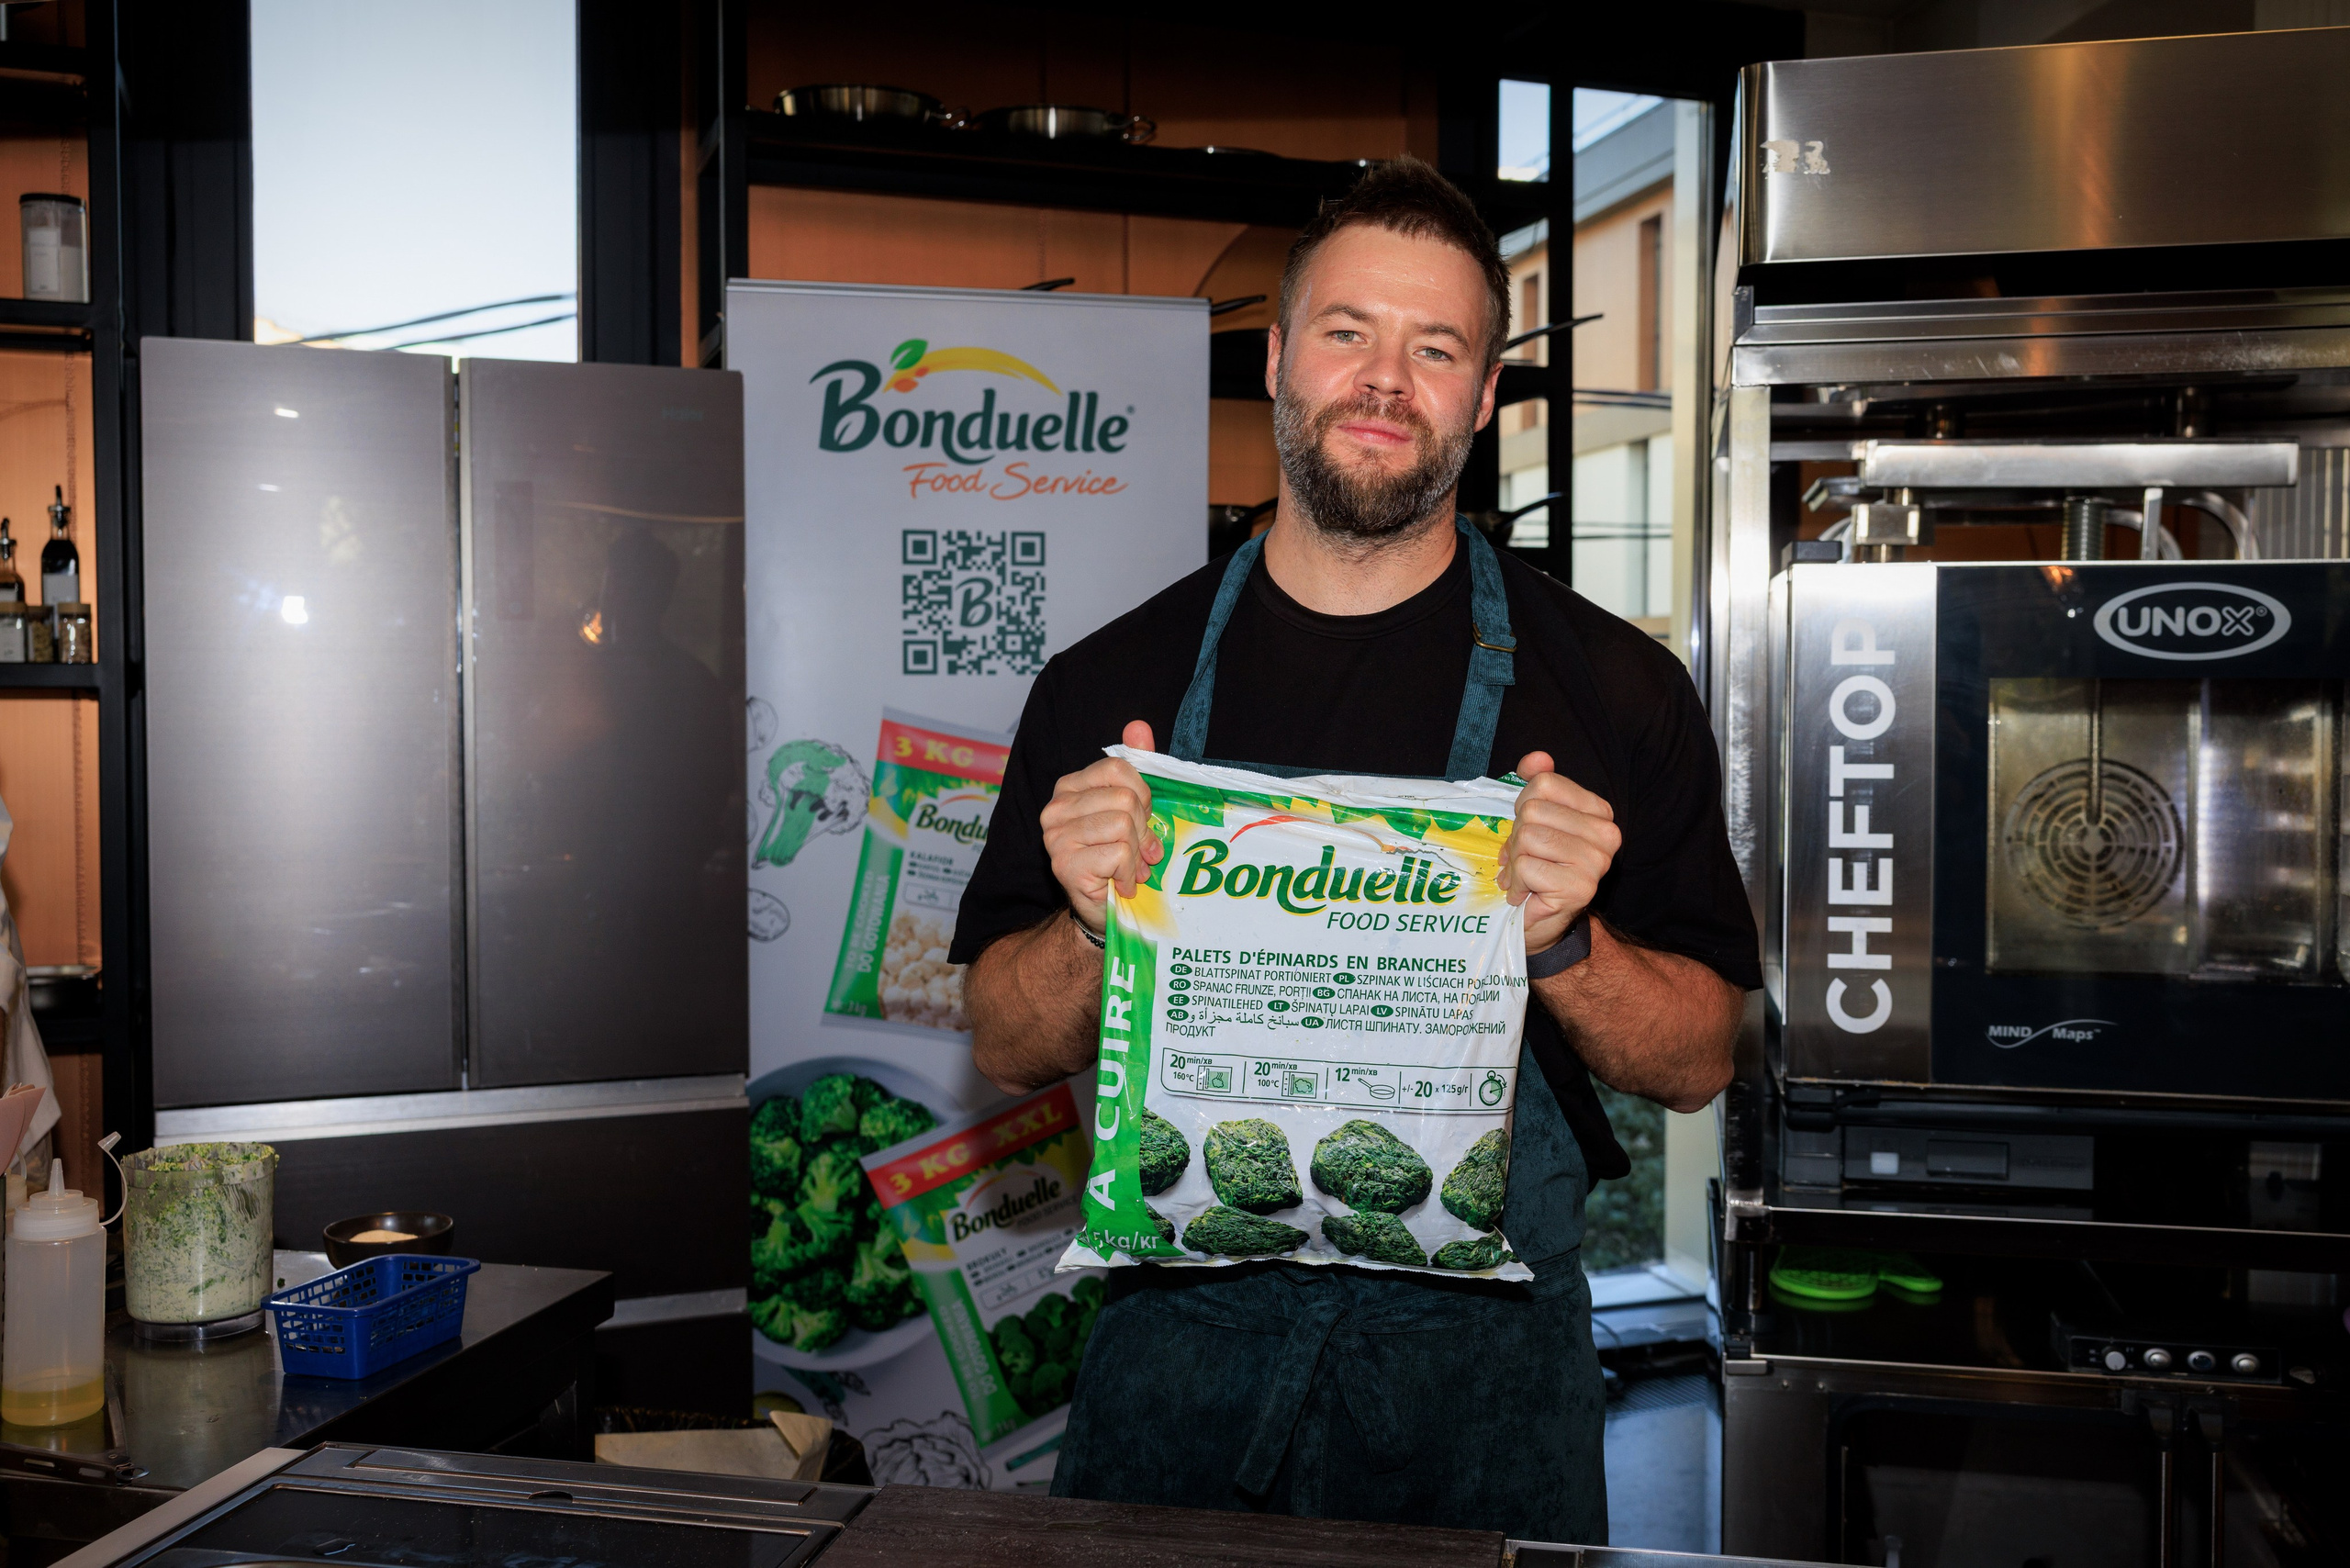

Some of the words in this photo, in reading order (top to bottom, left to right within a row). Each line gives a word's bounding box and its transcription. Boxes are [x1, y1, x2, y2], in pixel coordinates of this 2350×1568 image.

[902, 462, 988, 498] Food
[990, 462, 1128, 500] Service
[955, 577, 993, 627] B
[894, 736, 913, 757] 3
[923, 739, 975, 767] KG
[916, 803, 990, 845] Bondu
[1826, 617, 1897, 1035] CHEFTOP
[1177, 838, 1462, 916] Bonduelle
[1326, 912, 1389, 932] FOOD
[1395, 913, 1490, 934] SERVICE
[1172, 947, 1231, 964] PALETS
[1239, 949, 1338, 969] D'ÉPINARDS
[1347, 956, 1368, 969] EN
[1377, 957, 1467, 973] BRANCHES
[1171, 980, 1188, 990] RO
[1193, 980, 1233, 994] SPANAC
[1235, 982, 1276, 997] FRUNZE,
[1172, 965, 1190, 975] DE
[1194, 967, 1261, 980] BLATTSPINAT
[1264, 970, 1332, 983] PORTIONIERT
[1336, 974, 1352, 983] PL
[1357, 974, 1401, 986] SZPINAK
[1404, 976, 1415, 987] W
[1418, 975, 1464, 989] LIŚCIACH
[1170, 995, 1187, 1005] EE
[1192, 995, 1263, 1010] SPINATILEHED
[1270, 1001, 1287, 1011] LT
[1292, 999, 1337, 1017] ŠPINATŲ
[1339, 1003, 1370, 1016] LAPAI
[1373, 1006, 1390, 1015] LV
[1395, 1005, 1439, 1019] SPINĀTU
[1443, 1009, 1474, 1021] LAPAS
[1315, 988, 1332, 998] BG
[1337, 988, 1381, 1001] СПАНАК
[1383, 990, 1399, 1002] НА
[1401, 991, 1440, 1004] ЛИСТА,
[1443, 992, 1458, 1004] НА
[1169, 1010, 1186, 1020] AB
[1304, 1018, 1321, 1027] UA
[1325, 1018, 1362, 1031] ЛИСТЯ
[1365, 1021, 1422, 1034] ШПИНАТУ.
[1425, 1021, 1505, 1036] ЗАМОРОЖЕНИЙ
[1165, 1022, 1216, 1038] ПРОДУКТ
[1988, 1025, 2032, 1037] MIND
[1094, 956, 1136, 1141] CUIRE
[1169, 1054, 1186, 1070] 20
[1254, 1062, 1270, 1076] 20
[1335, 1068, 1350, 1081] 12
[889, 1172, 912, 1195] 3
[918, 1142, 971, 1181] KG
[991, 1103, 1063, 1147] XXL
[950, 1176, 1060, 1242] Bonduelle
